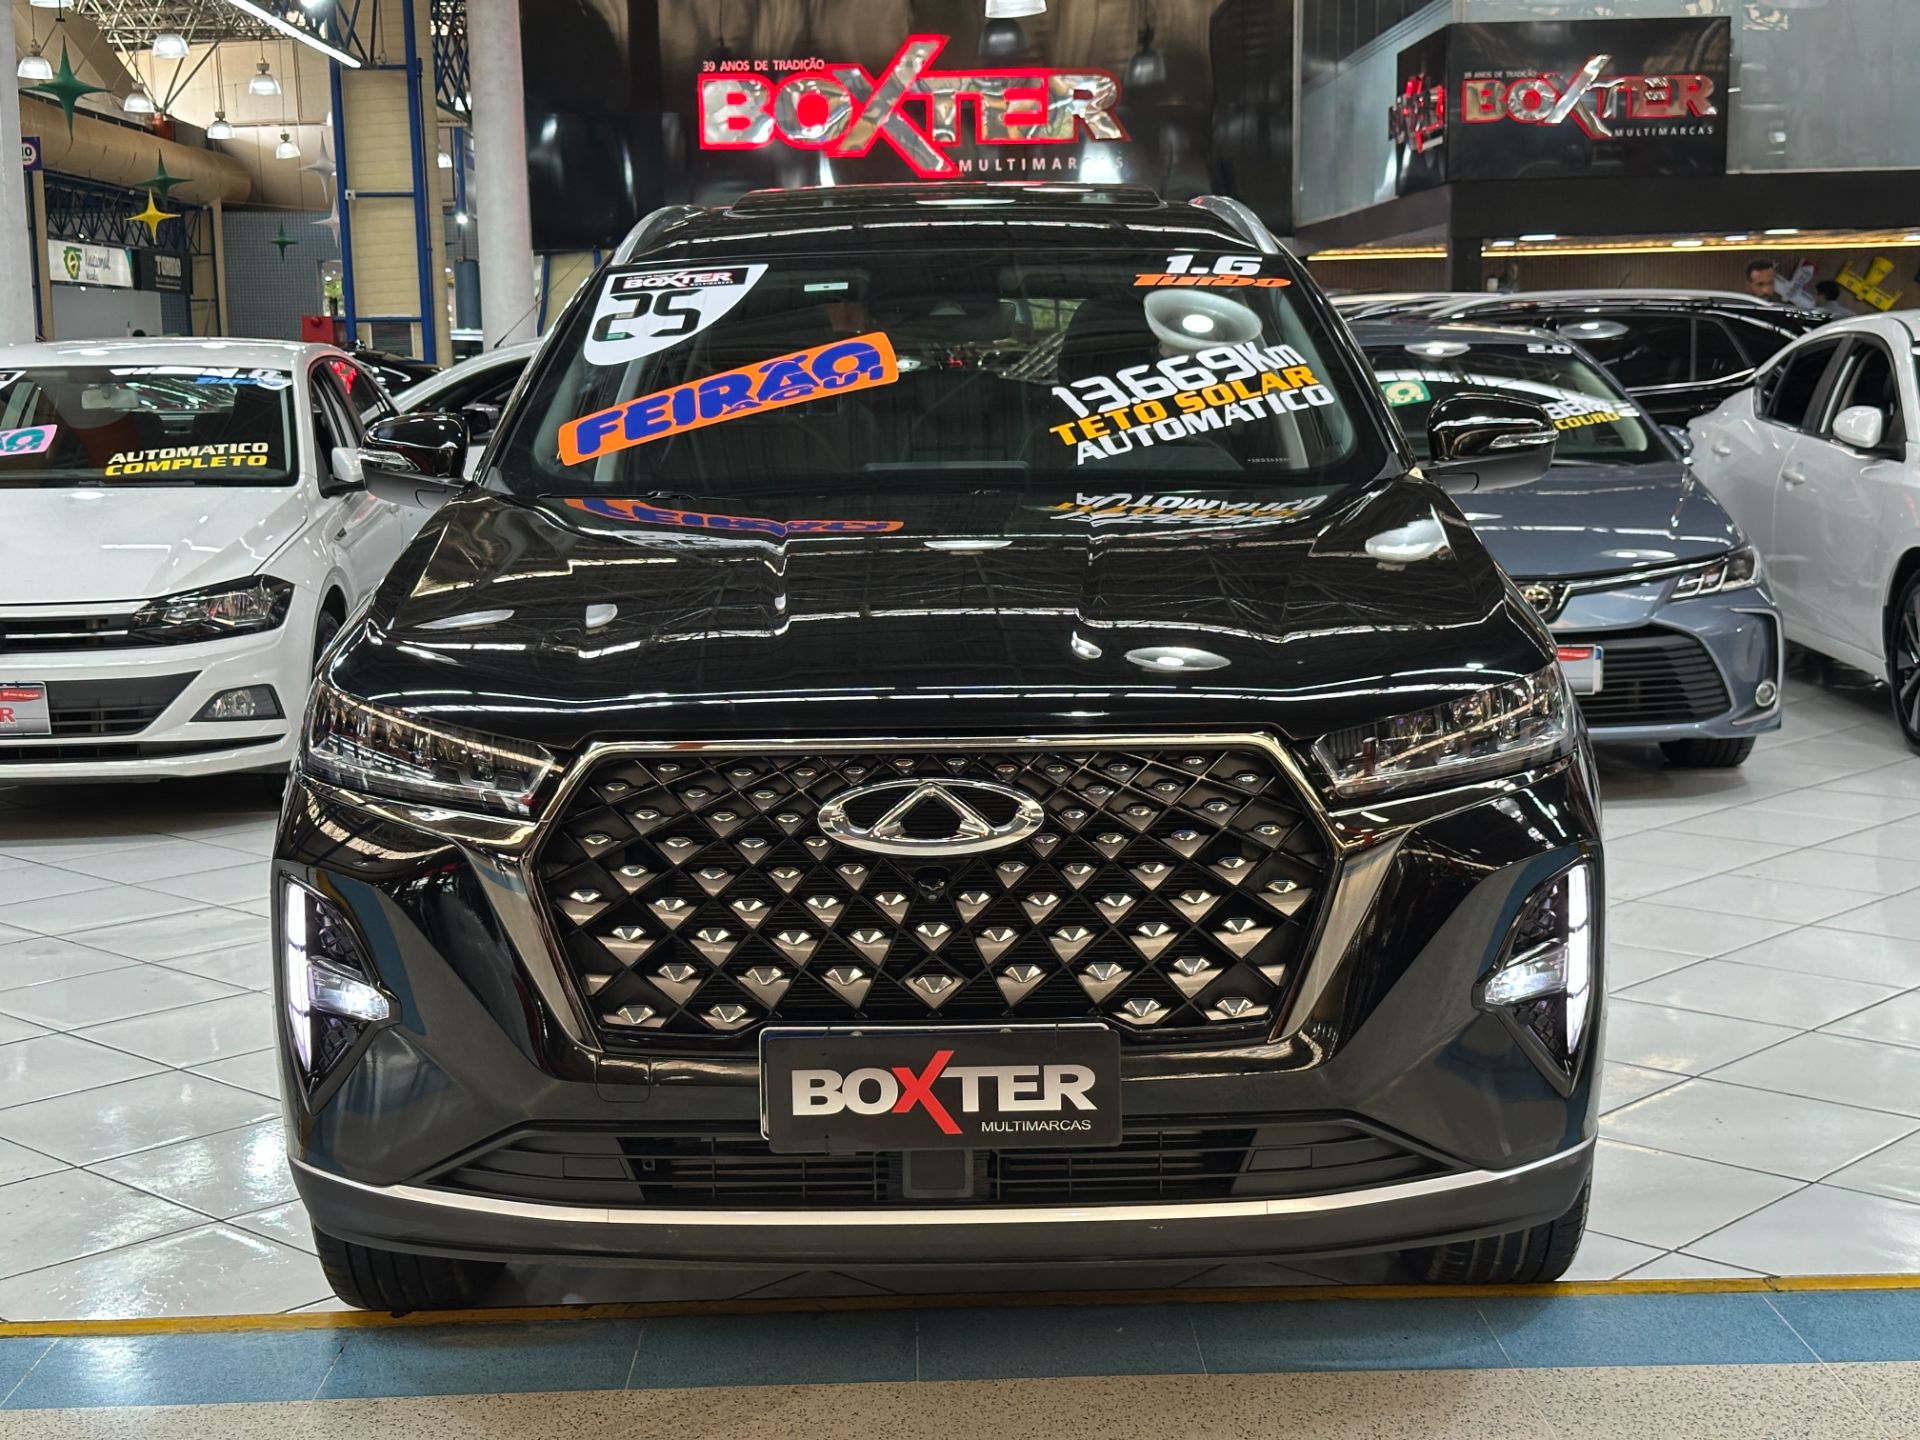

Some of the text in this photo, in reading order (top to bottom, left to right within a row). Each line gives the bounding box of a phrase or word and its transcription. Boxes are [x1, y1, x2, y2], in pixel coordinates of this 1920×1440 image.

[703, 57, 825, 72] 39 ANOS DE TRADIÇÃO
[698, 34, 1131, 178] BOXTER
[1461, 54, 1717, 141] BOXTER
[1614, 126, 1714, 138] MULTIMARCAS
[1165, 254, 1263, 276] 1.6
[623, 271, 733, 290] BOXTER
[592, 288, 702, 342] 25
[1050, 366, 1320, 446] TETO SOLAR
[105, 455, 268, 477] COMPLETO
[791, 1050, 1098, 1134] BOXTER
[981, 1119, 1091, 1133] MULTIMARCAS
